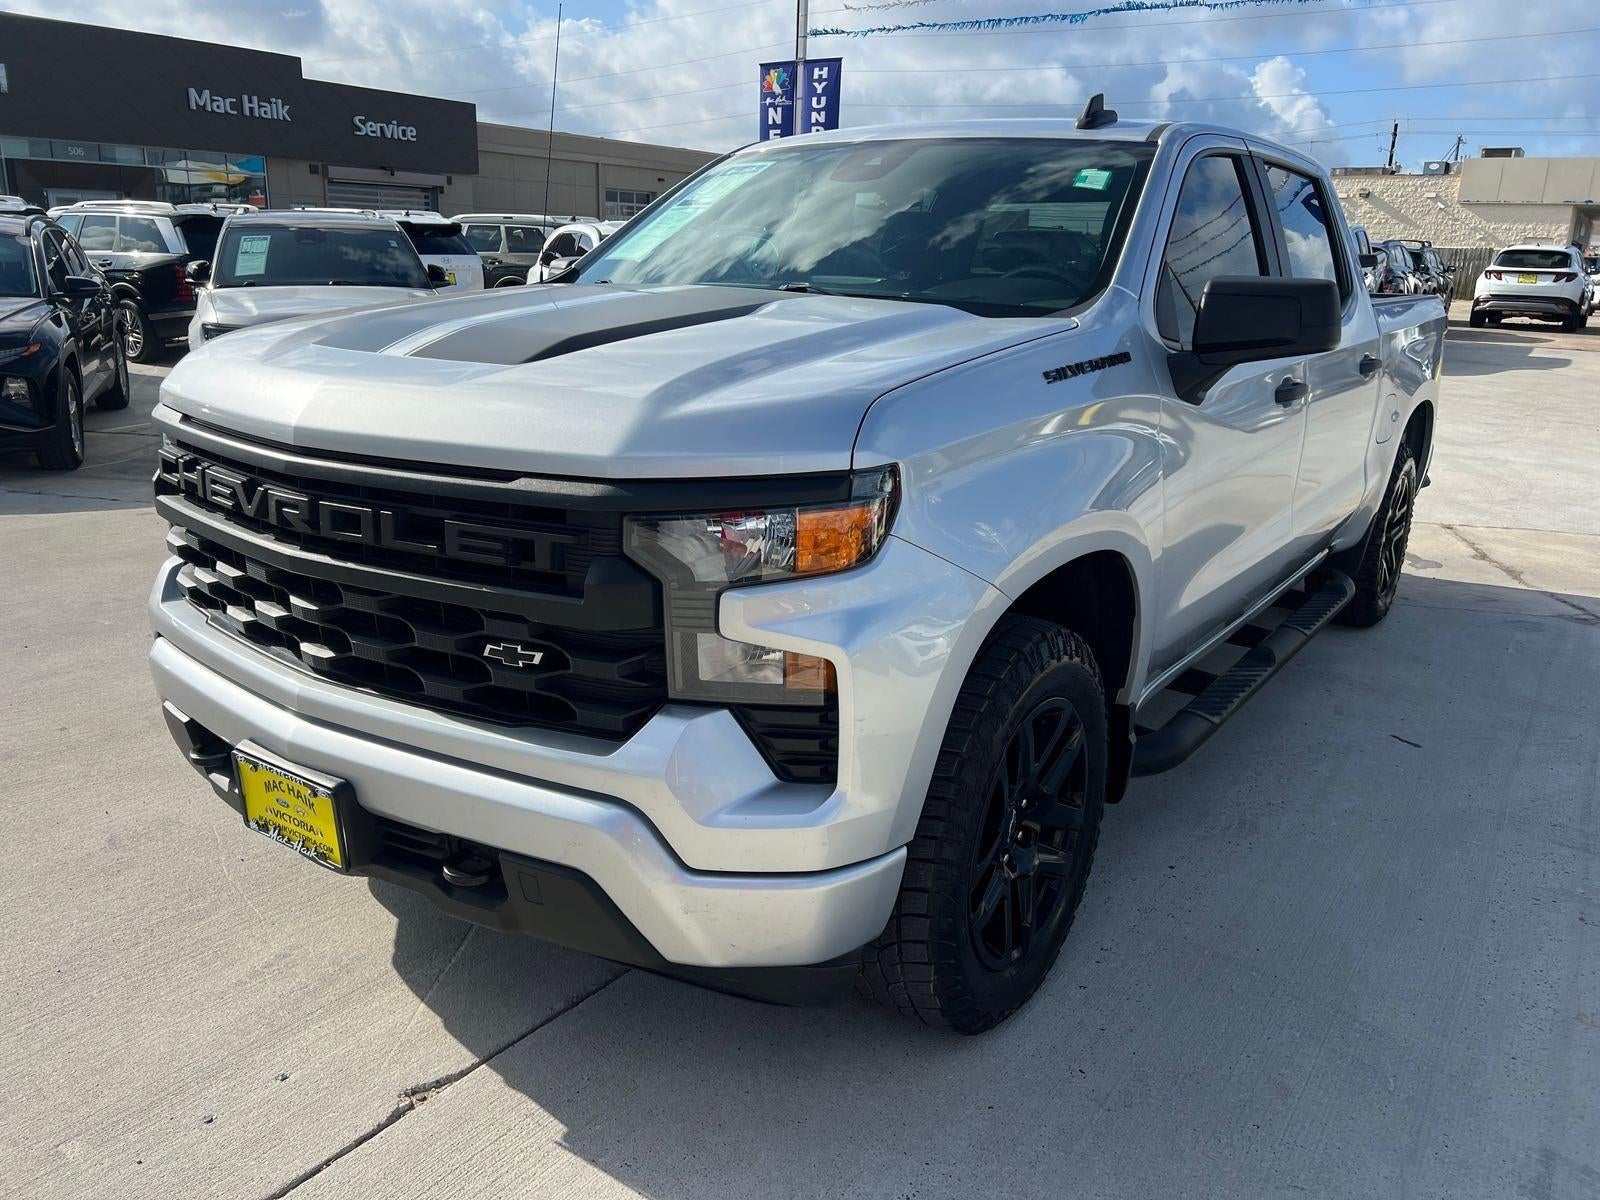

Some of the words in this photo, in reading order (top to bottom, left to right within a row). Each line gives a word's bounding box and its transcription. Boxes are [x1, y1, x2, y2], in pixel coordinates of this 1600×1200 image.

[187, 87, 238, 115] Mac
[242, 94, 292, 122] Haik
[352, 115, 417, 141] Service
[67, 146, 85, 157] 506
[157, 447, 592, 572] CHEVROLET
[264, 779, 286, 794] MAC
[286, 783, 318, 817] HAIK
[272, 807, 317, 836] VICTORIA
[268, 825, 290, 845] Mac
[293, 837, 319, 859] Haik
